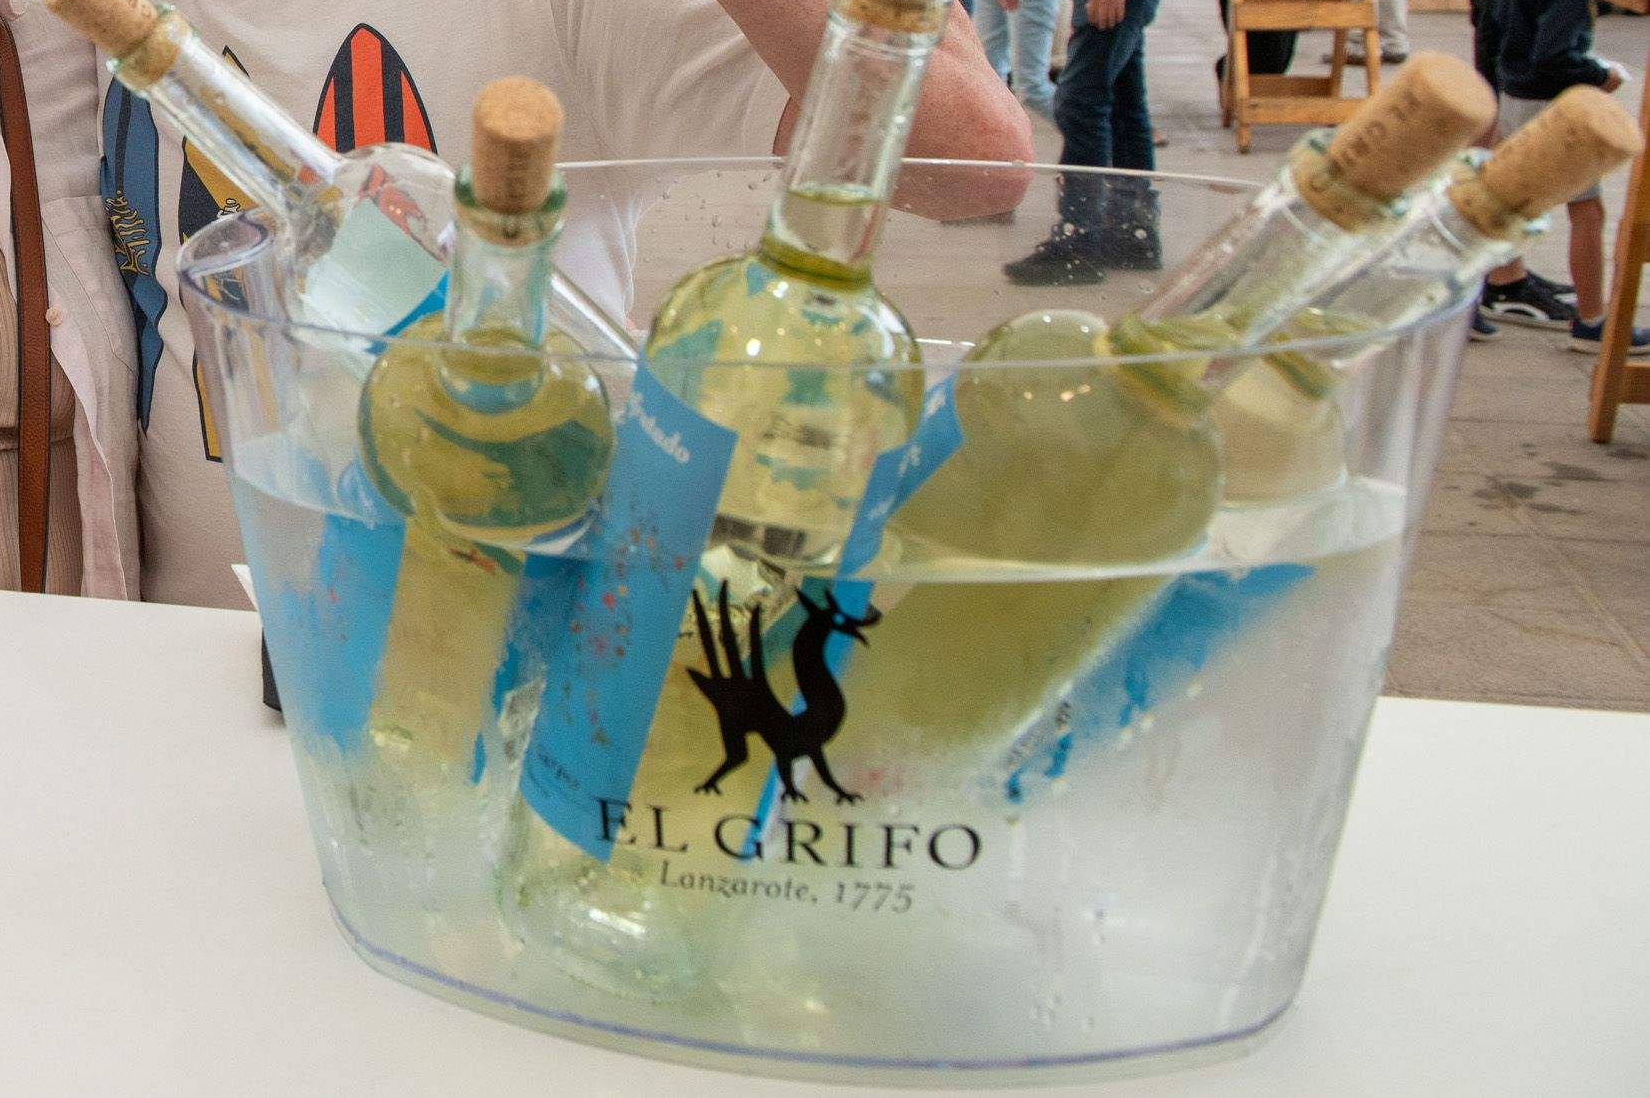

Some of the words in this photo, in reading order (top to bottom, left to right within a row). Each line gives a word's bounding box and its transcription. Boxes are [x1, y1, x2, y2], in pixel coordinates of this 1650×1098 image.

[596, 798, 689, 854] EL
[713, 813, 983, 871] GRIFO
[660, 858, 818, 903] Lanzarote,
[834, 878, 916, 914] 1775
